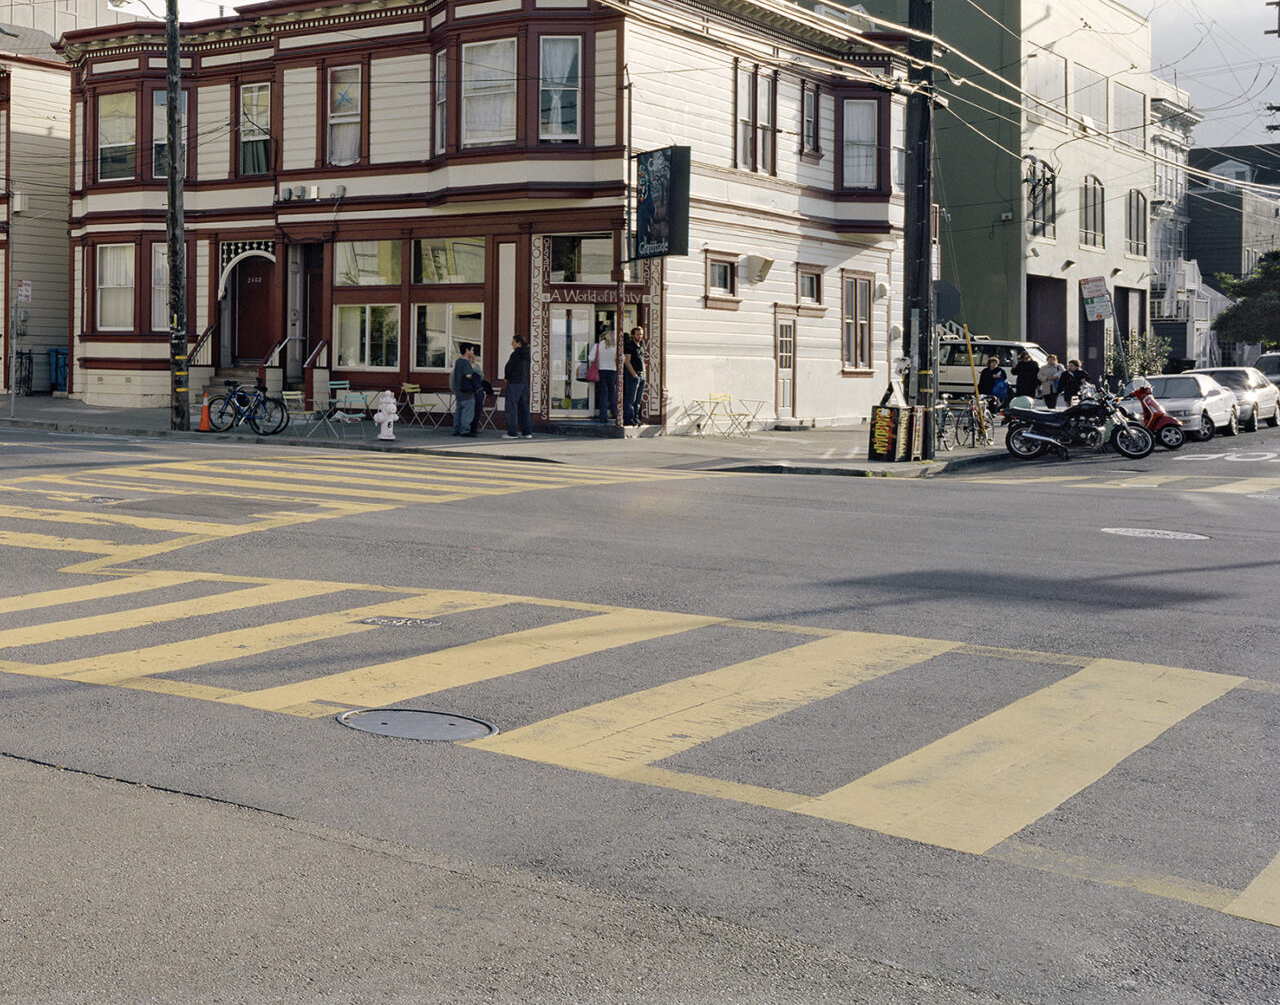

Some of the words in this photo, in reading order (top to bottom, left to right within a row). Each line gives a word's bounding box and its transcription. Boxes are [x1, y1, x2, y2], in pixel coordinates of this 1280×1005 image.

[532, 237, 541, 279] COLD
[532, 283, 541, 347] PROCESS
[550, 290, 561, 302] A
[564, 290, 596, 302] World
[598, 290, 608, 302] of
[609, 290, 640, 303] Plnty
[652, 309, 660, 348] BEER
[531, 351, 540, 412] COFFEE
[649, 362, 660, 411] WINE
